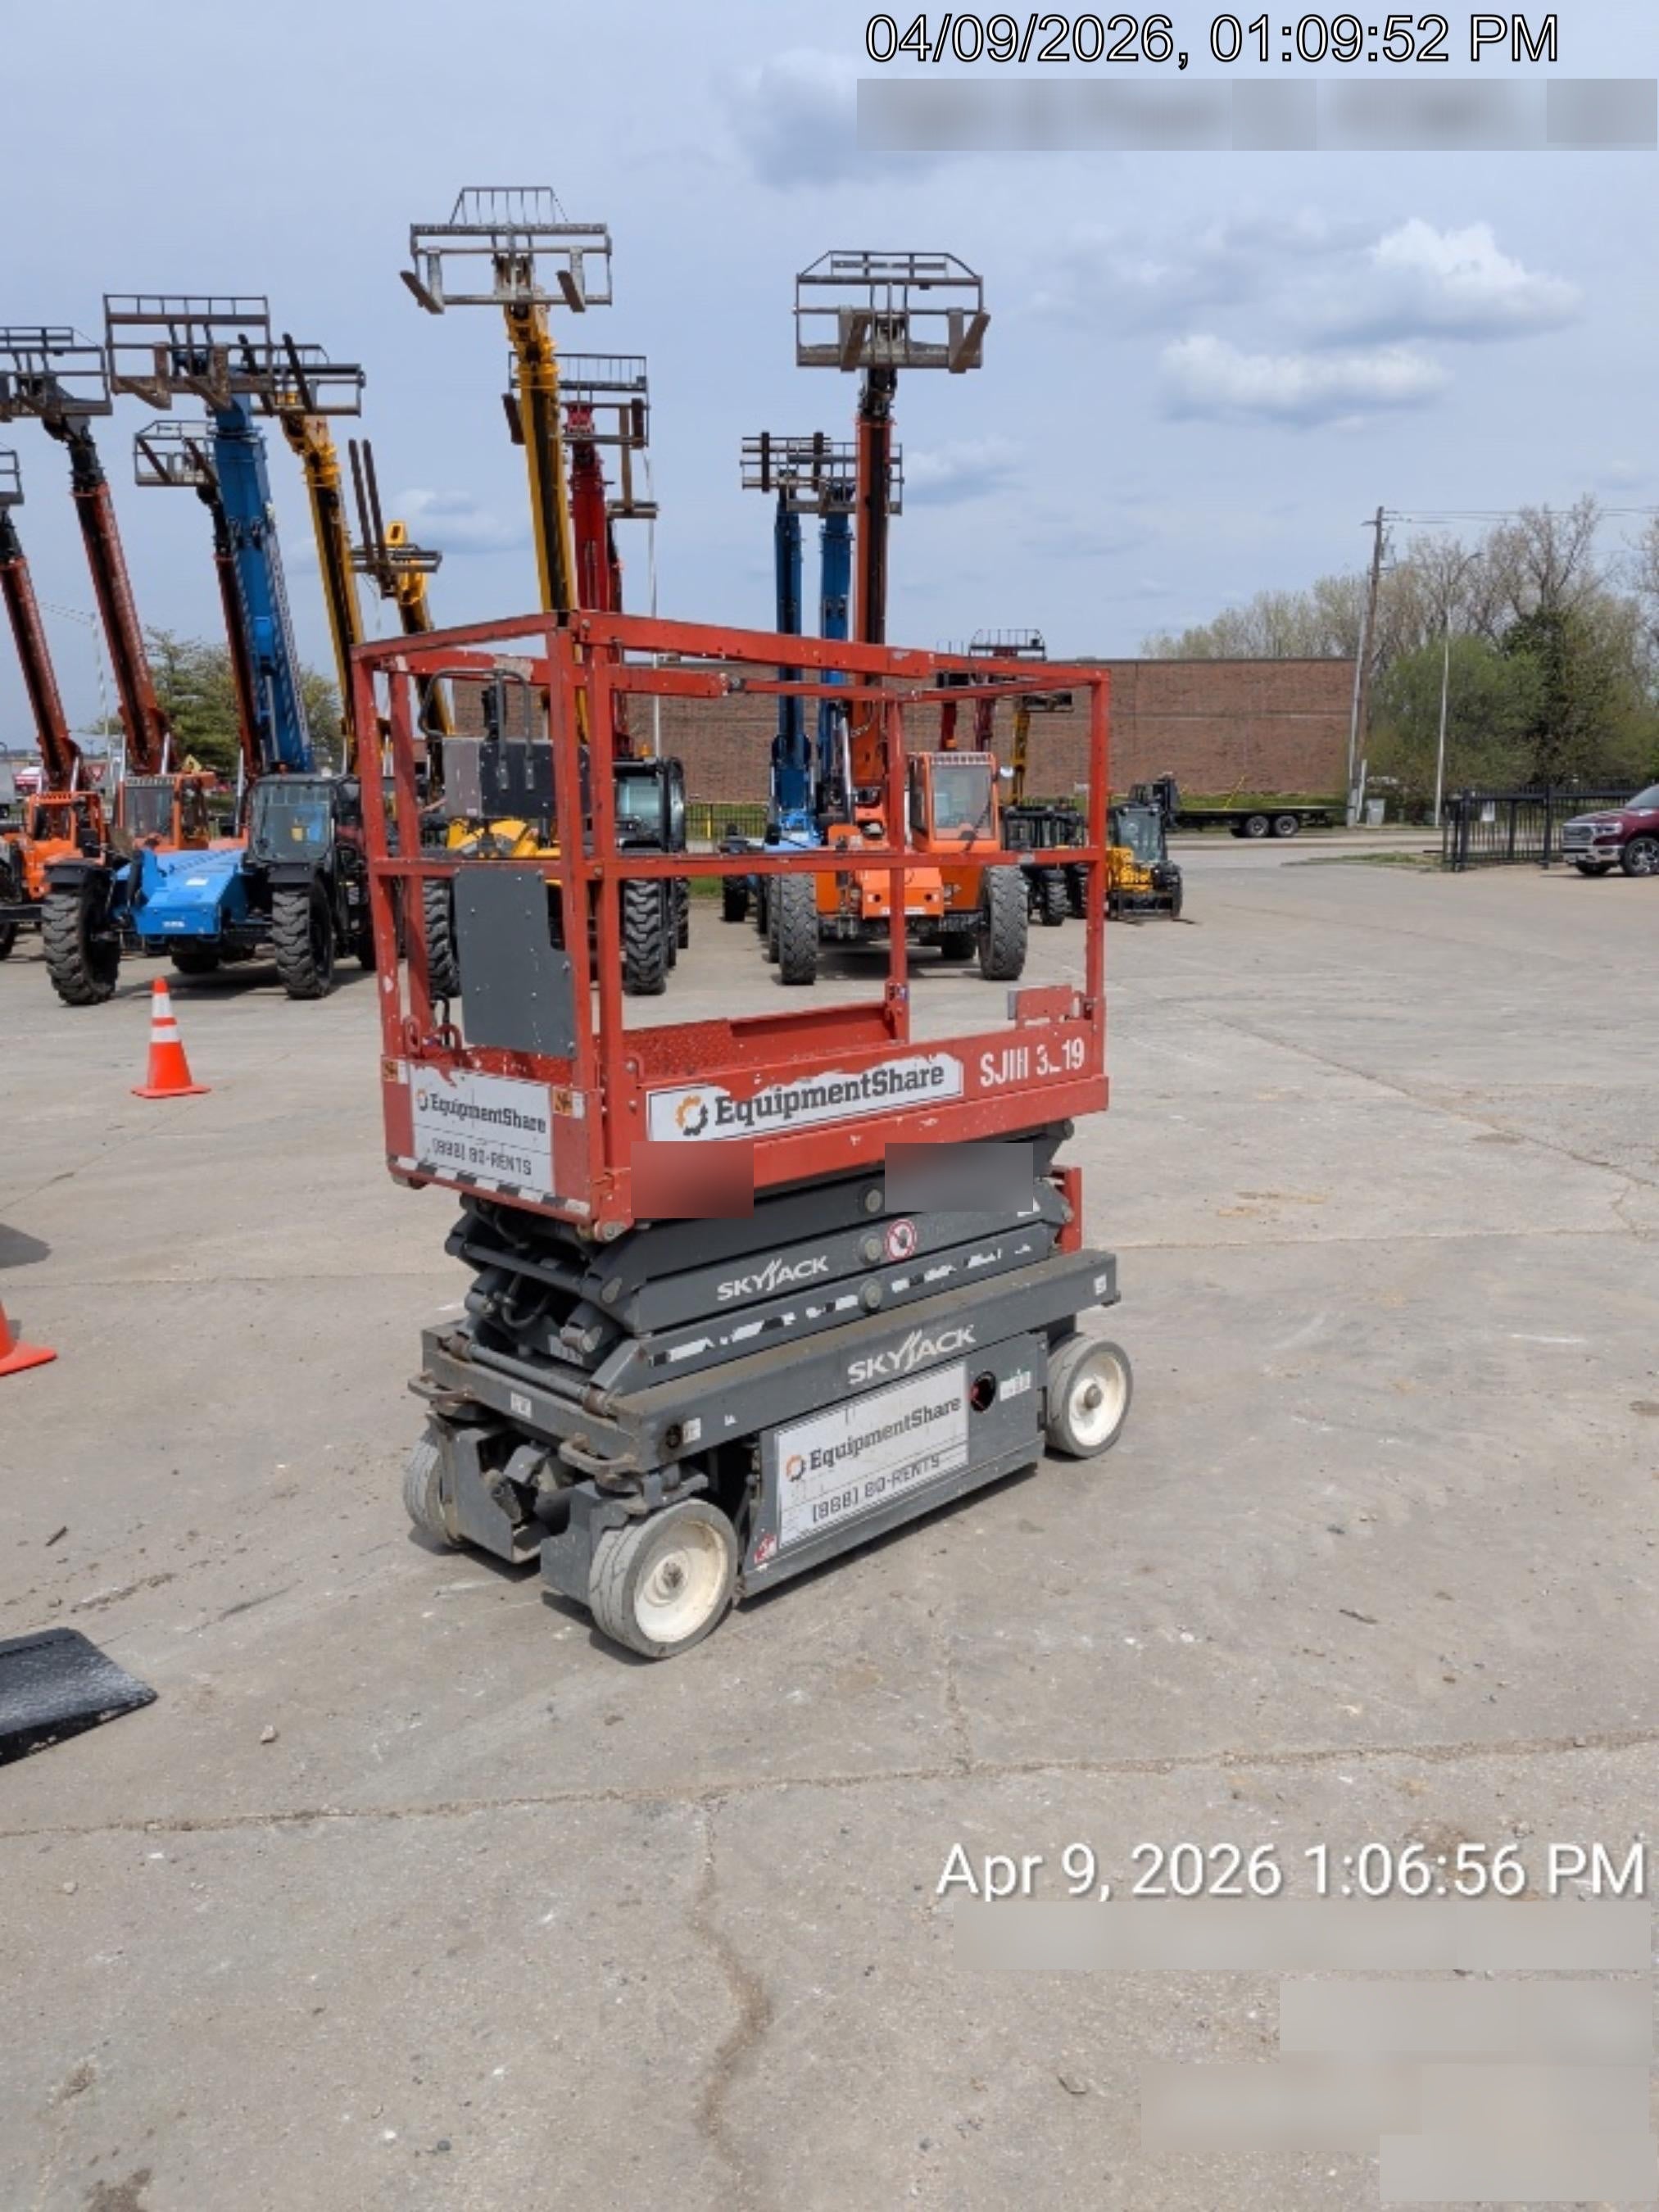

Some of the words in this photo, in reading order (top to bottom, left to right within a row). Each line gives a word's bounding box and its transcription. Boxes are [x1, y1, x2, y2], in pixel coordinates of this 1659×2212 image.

[1036, 1036, 1086, 1077] 319
[429, 1092, 546, 1134] EquipmentShare
[714, 1065, 944, 1127] EquipmentShare
[717, 1254, 829, 1301] SKYJACK
[847, 1323, 977, 1385] SKYJACK
[809, 1397, 962, 1471] EquipmentShare
